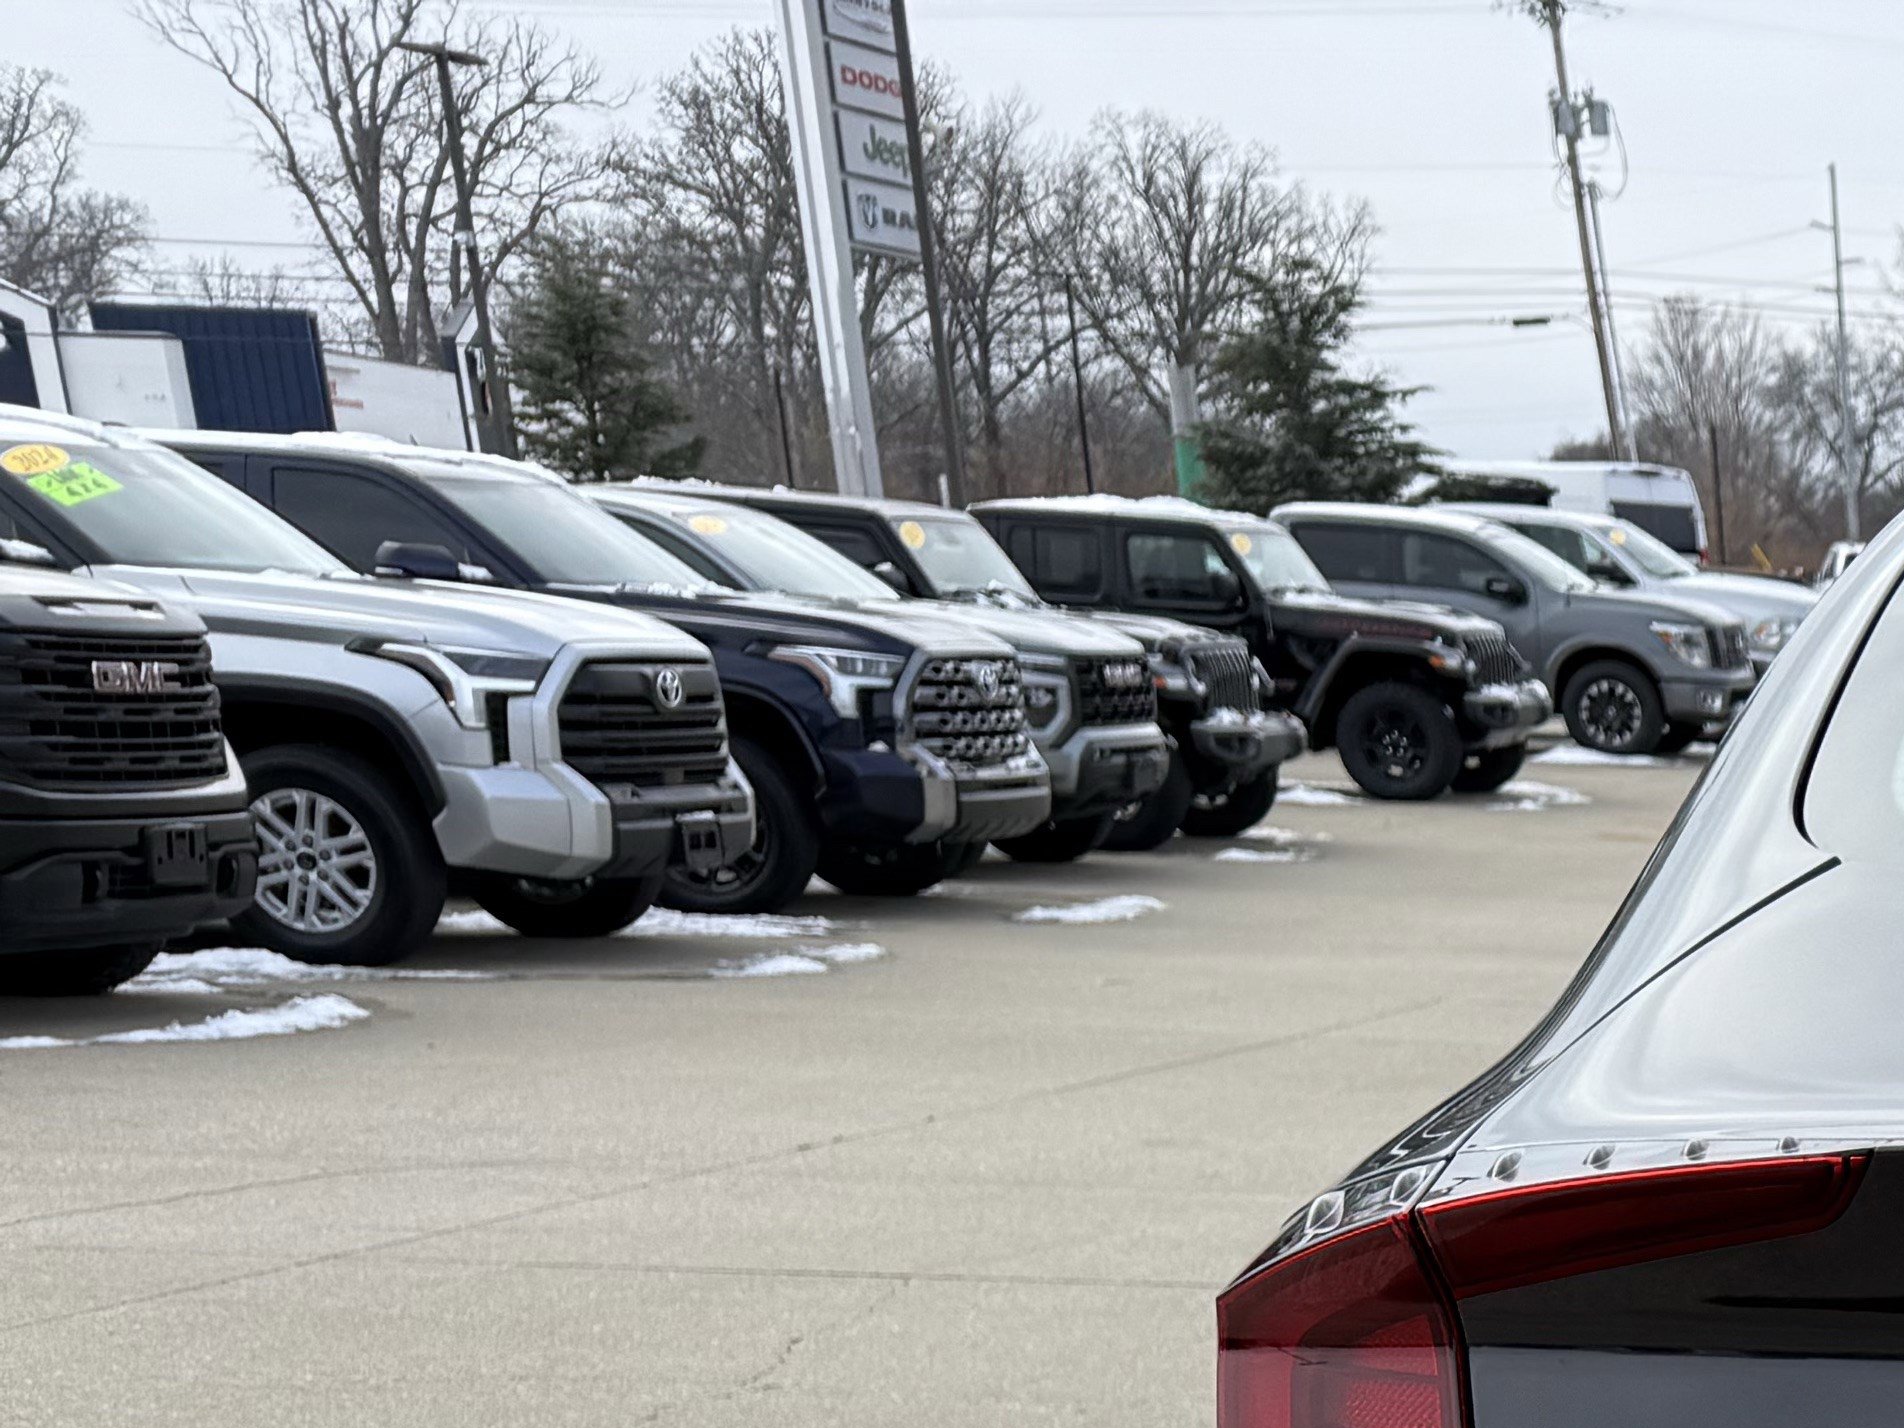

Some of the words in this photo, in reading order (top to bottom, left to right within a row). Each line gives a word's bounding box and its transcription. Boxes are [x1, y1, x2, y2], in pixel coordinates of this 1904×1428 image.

[841, 64, 903, 98] DODG
[882, 207, 918, 231] RA
[91, 660, 181, 694] GMC
